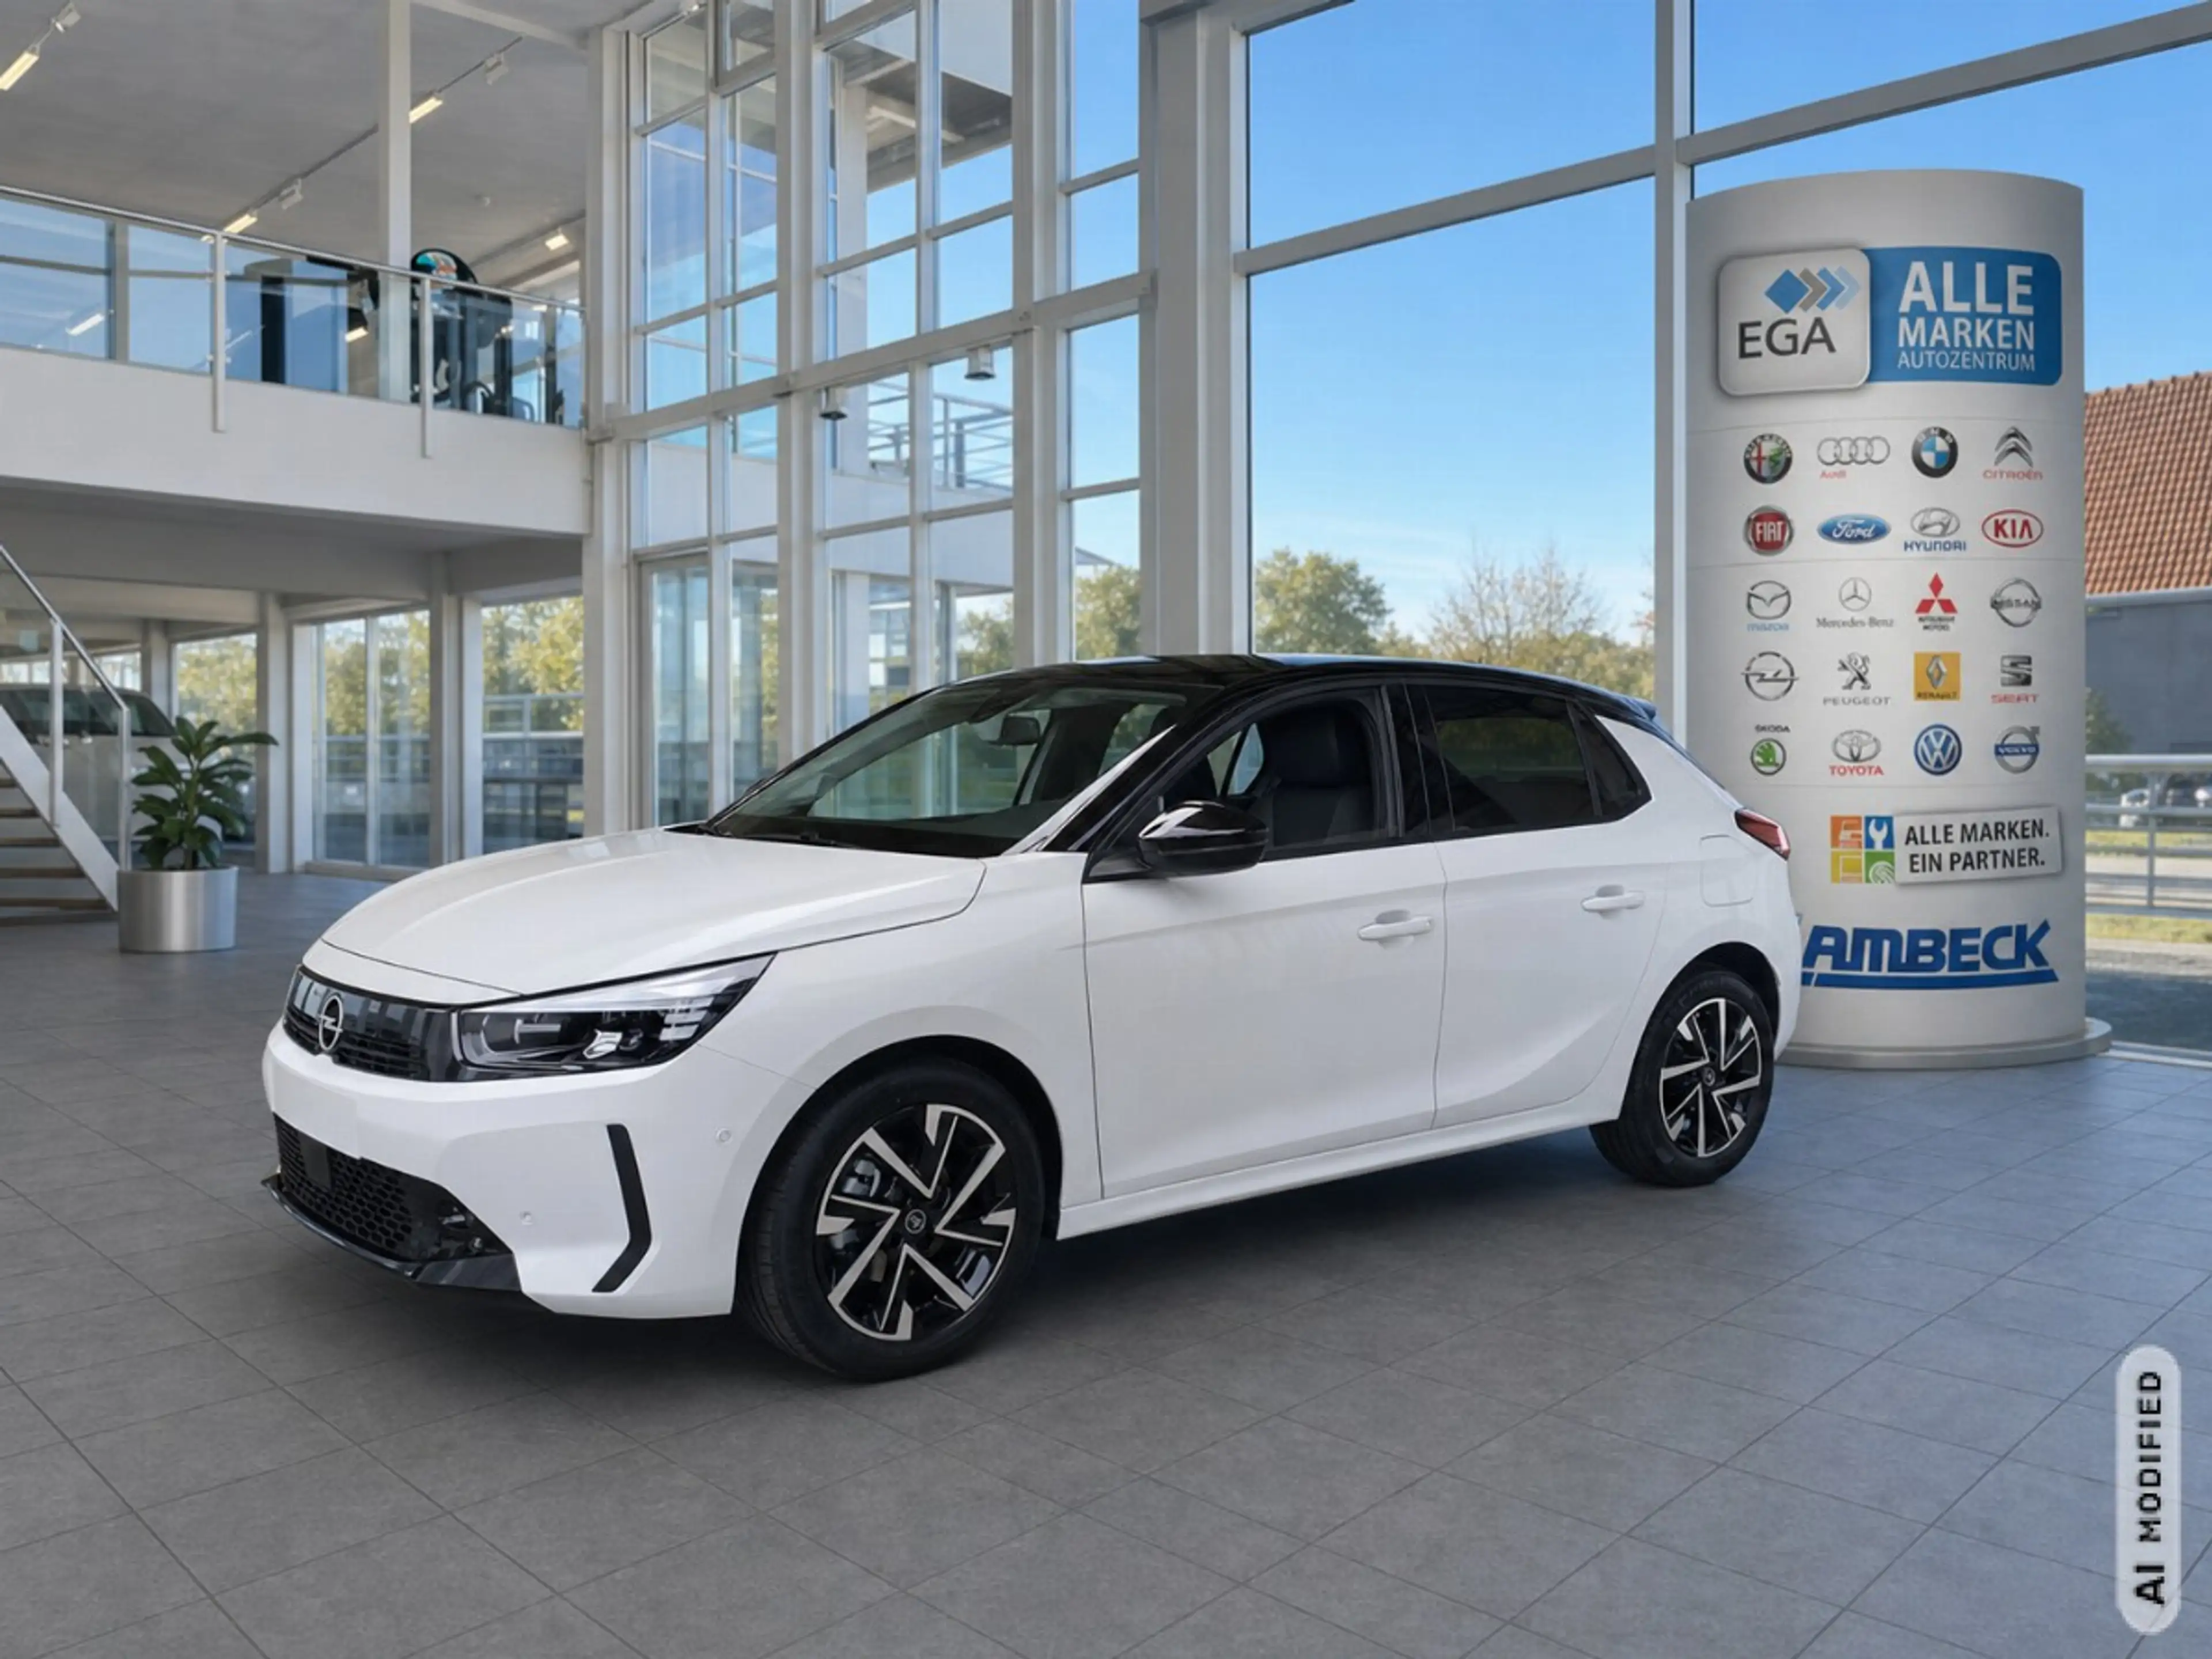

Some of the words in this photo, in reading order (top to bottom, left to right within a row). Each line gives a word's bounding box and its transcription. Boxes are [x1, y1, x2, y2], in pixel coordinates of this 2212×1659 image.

[1899, 260, 2034, 316] ALLE
[1738, 316, 1836, 359] EGA
[1898, 317, 2035, 351] MARKEN
[1897, 351, 2035, 372] AUTOZENTRUM
[1755, 521, 1785, 543] FIAT
[1832, 520, 1876, 539] Ford
[1994, 518, 2033, 539] KIA
[1904, 540, 1966, 552] HYUNDAI
[1823, 696, 1891, 706] PEUGEOT
[1829, 764, 1884, 777] TOYOTA
[1904, 824, 1954, 846] ALLE
[1960, 818, 2050, 843] MARKEN.
[1910, 853, 1942, 873] EIN
[1949, 847, 2046, 871] PARTNER.
